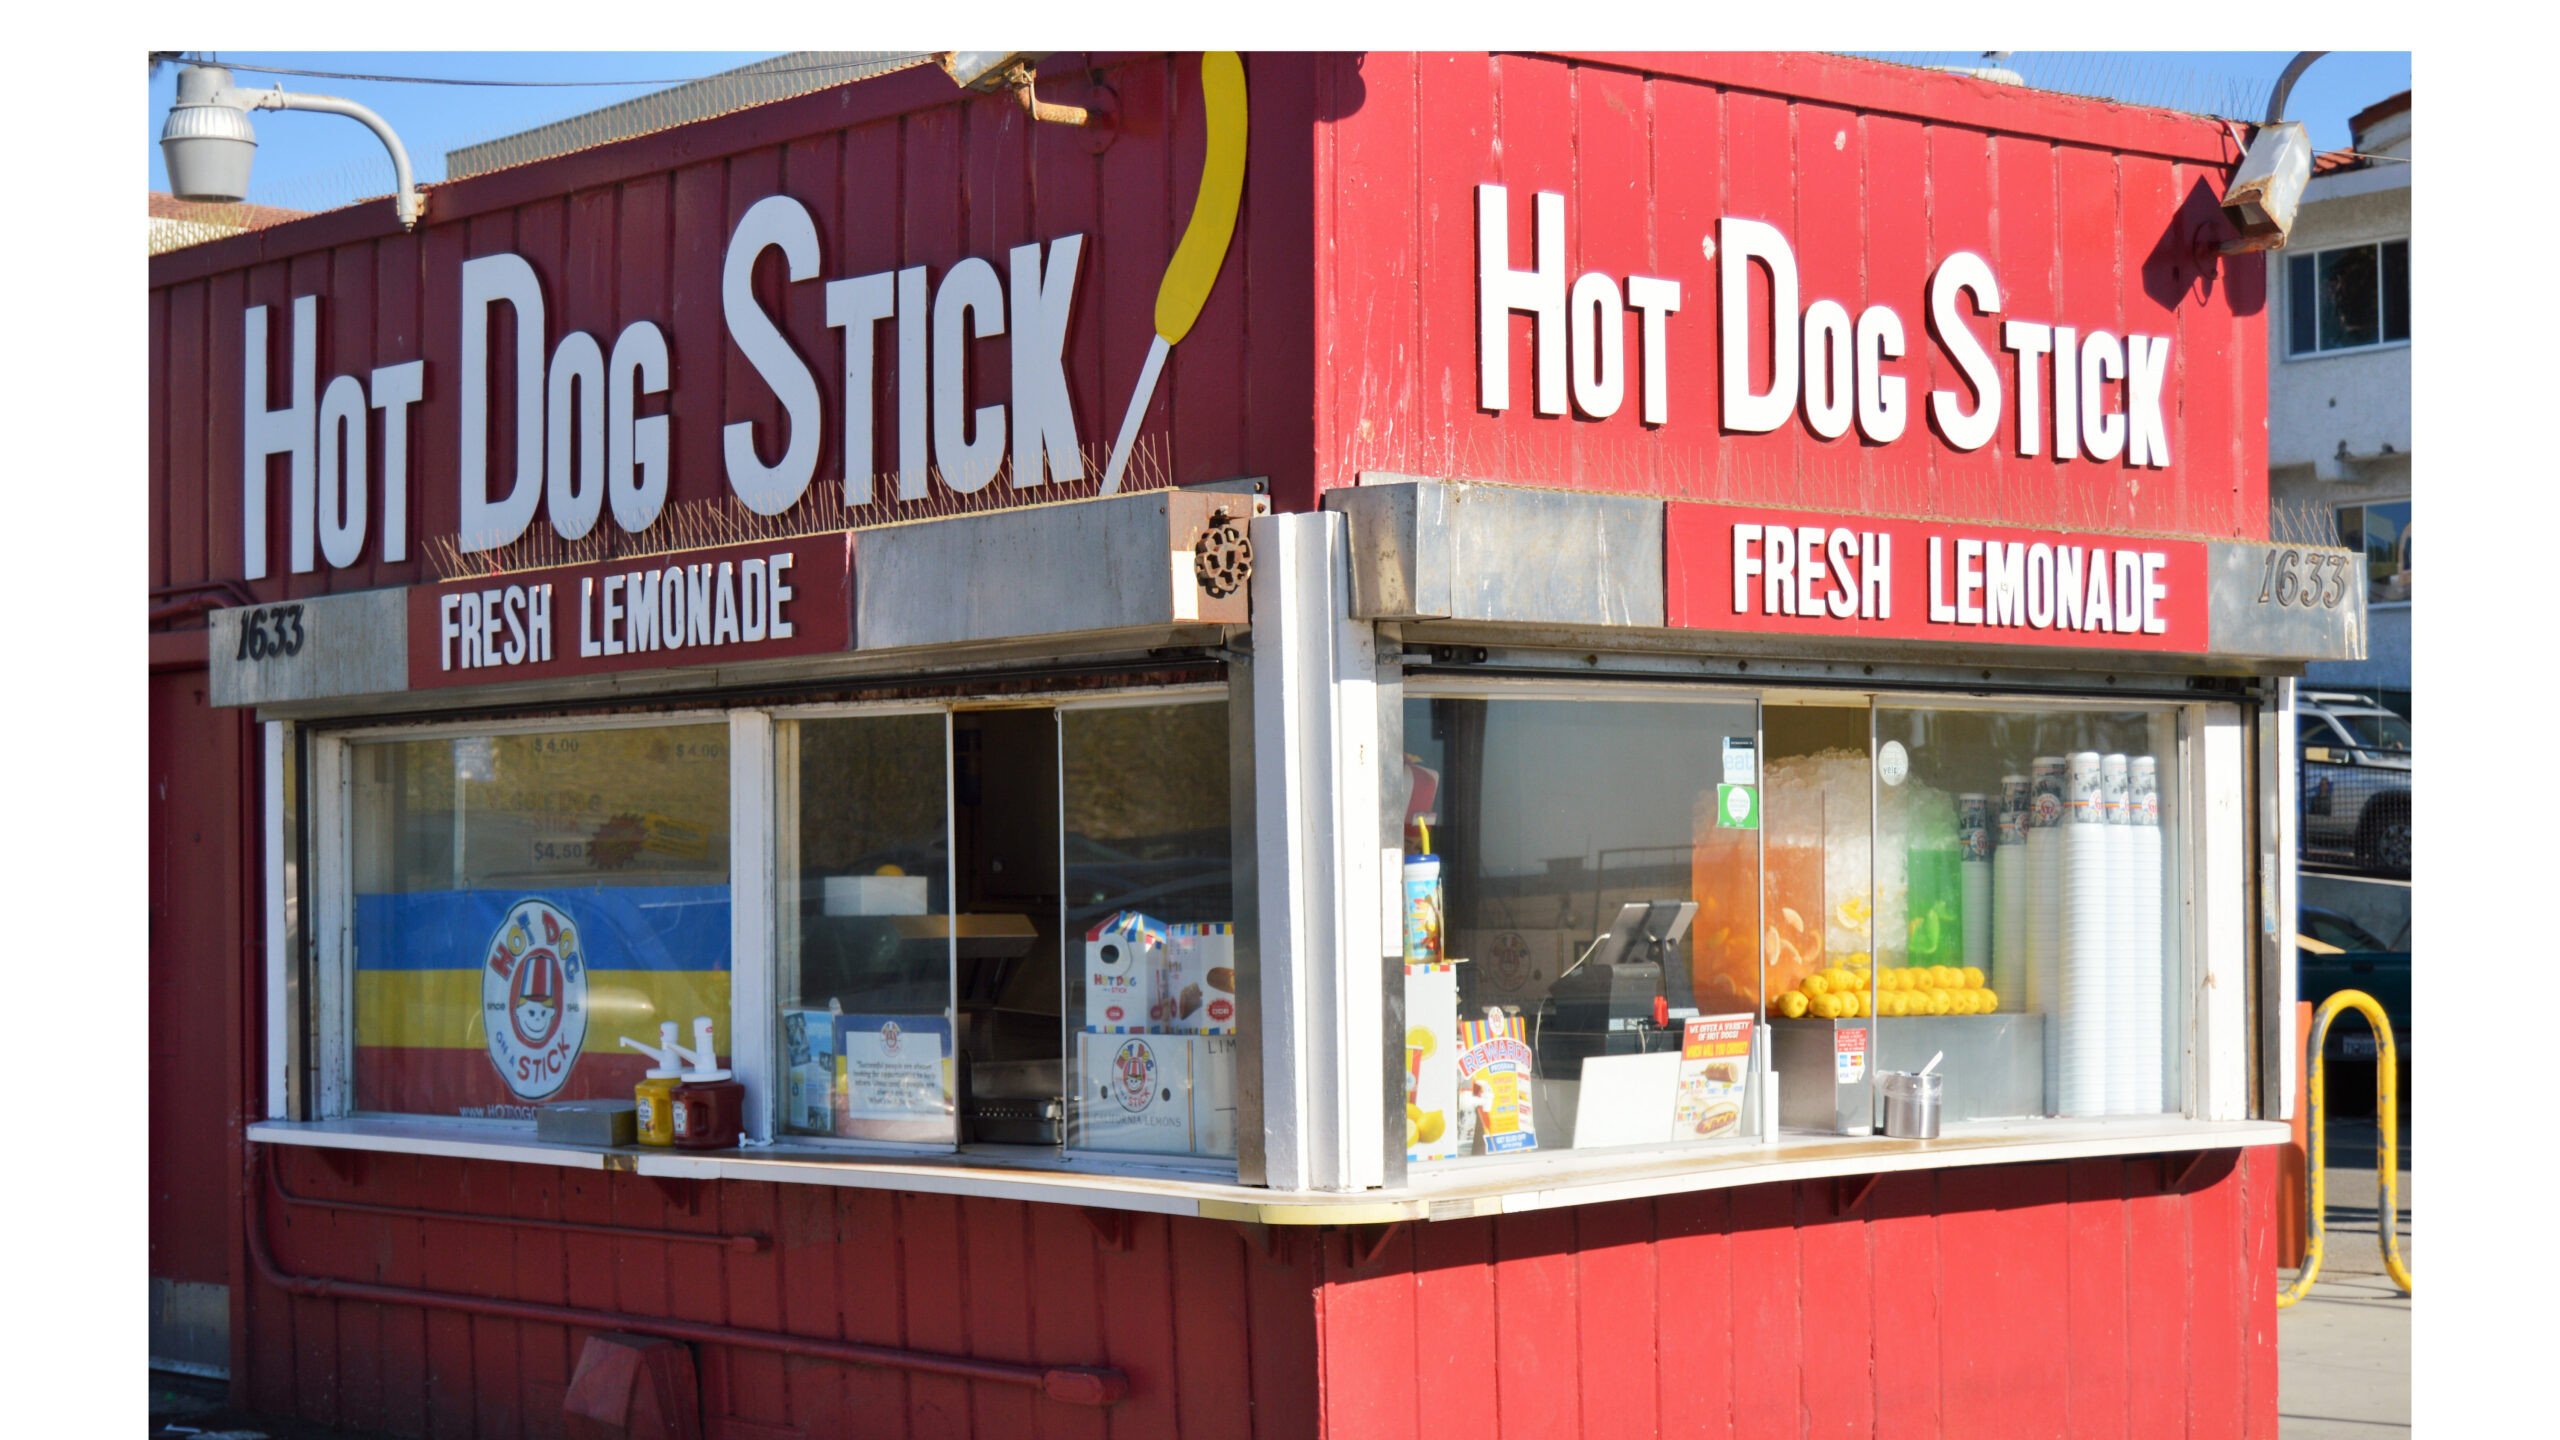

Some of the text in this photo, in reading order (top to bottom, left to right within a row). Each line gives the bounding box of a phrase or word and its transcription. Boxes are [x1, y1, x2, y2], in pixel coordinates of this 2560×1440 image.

[1475, 183, 2170, 468] HOT DOG STICK
[244, 195, 1088, 581] HOT DOG STICK
[440, 552, 794, 672] FRESH LEMONADE
[1732, 523, 2167, 635] FRESH LEMONADE
[2258, 548, 2347, 609] 1633
[236, 604, 305, 662] 1633
[533, 842, 583, 862] $4.50
[488, 910, 580, 984] HOT DOG
[517, 1032, 571, 1084] STICK
[1463, 1039, 1530, 1075] REWARDS
